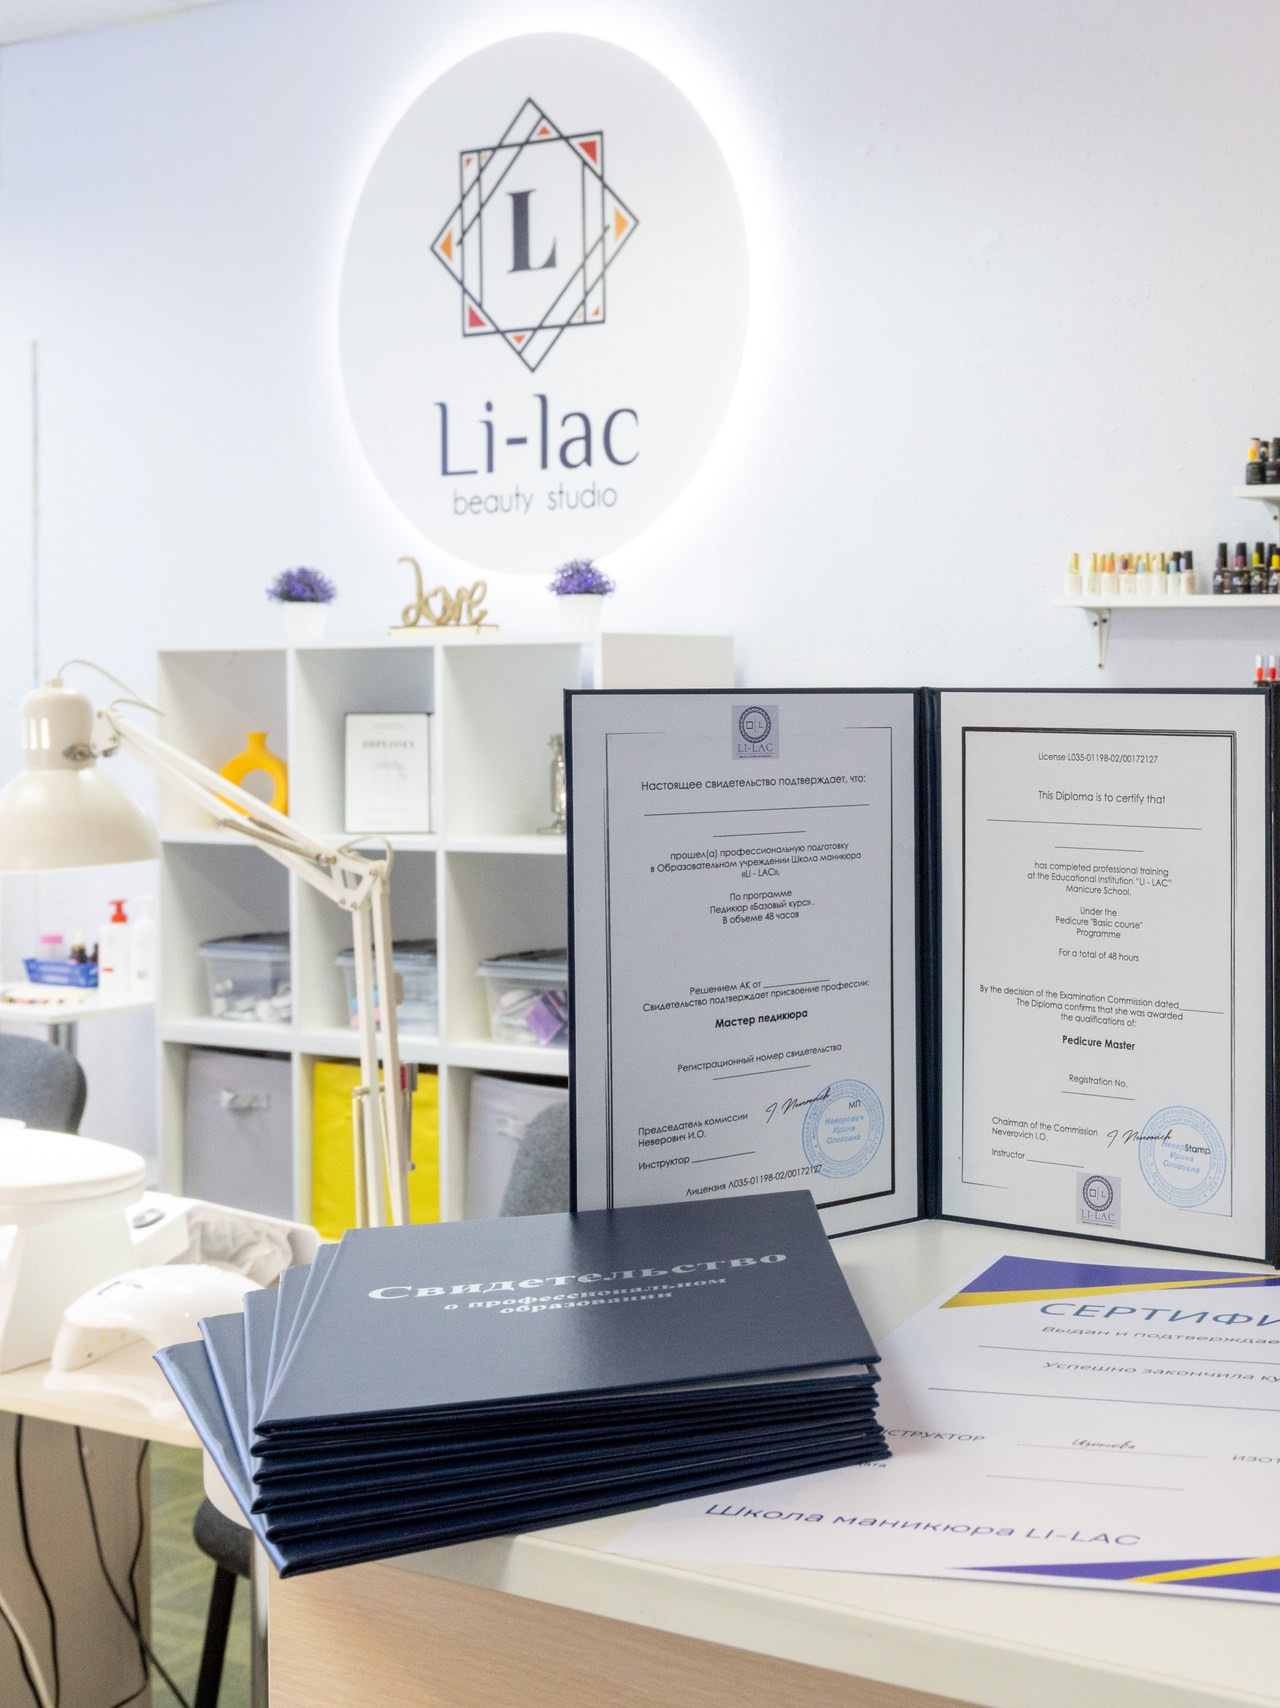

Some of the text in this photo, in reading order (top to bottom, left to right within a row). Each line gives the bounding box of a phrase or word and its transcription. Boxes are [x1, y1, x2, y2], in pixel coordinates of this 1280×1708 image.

[505, 188, 557, 273] L
[433, 393, 640, 477] Li-lac
[454, 481, 618, 517] beauty studio
[738, 744, 773, 753] LI-LAC
[1039, 752, 1066, 761] License
[642, 781, 702, 791] Настоящее
[705, 779, 776, 788] свидетельство
[779, 776, 847, 786] подтверждает,
[1038, 790, 1165, 805] This Diploma is to certify that
[1056, 916, 1089, 925] Pedicure
[1077, 928, 1121, 938] Programme
[715, 1010, 807, 1028] Мастер педикюра
[1063, 1035, 1135, 1050] Pedicure Master
[678, 1044, 842, 1072] Регистрационный номер свидетельства
[1069, 1074, 1127, 1088] Registration No.
[992, 1148, 1025, 1159] Instructor
[1184, 1144, 1211, 1155] Stamp
[686, 1182, 726, 1196] Лицензия
[1081, 1210, 1115, 1221] LI-LAC
[368, 1251, 787, 1301] Свидетельство
[444, 1276, 727, 1311] о профессиональном
[499, 1291, 673, 1315] образовании
[1042, 1326, 1110, 1336] Выдан
[1042, 1362, 1136, 1374] Успешно
[1142, 1368, 1254, 1380] закончила
[882, 1429, 985, 1441] СТРУКТОР
[705, 1502, 1141, 1546] Школа маникюра LI-LAC
